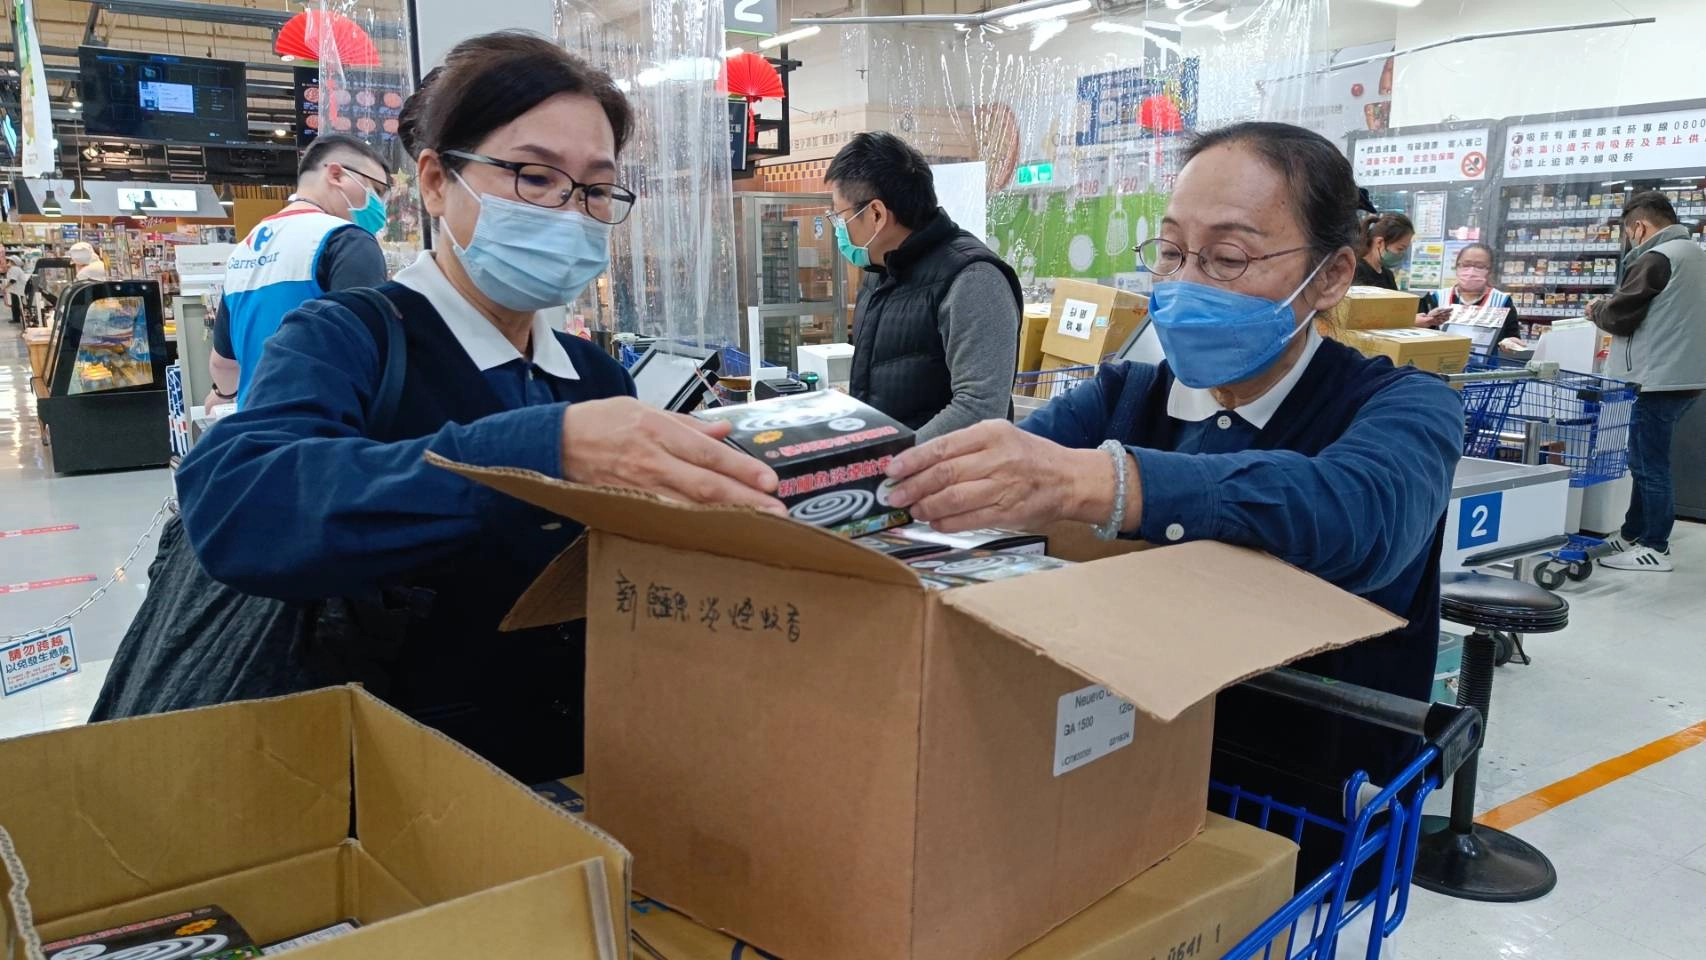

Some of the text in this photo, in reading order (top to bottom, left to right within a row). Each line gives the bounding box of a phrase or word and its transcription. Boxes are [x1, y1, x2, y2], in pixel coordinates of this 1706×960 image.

[1525, 133, 1706, 155] 未滿18歲不得吸菸及禁止供
[1471, 505, 1488, 537] 2
[6, 645, 70, 674] 以免發生危險
[8, 635, 64, 662] 請勿跨越
